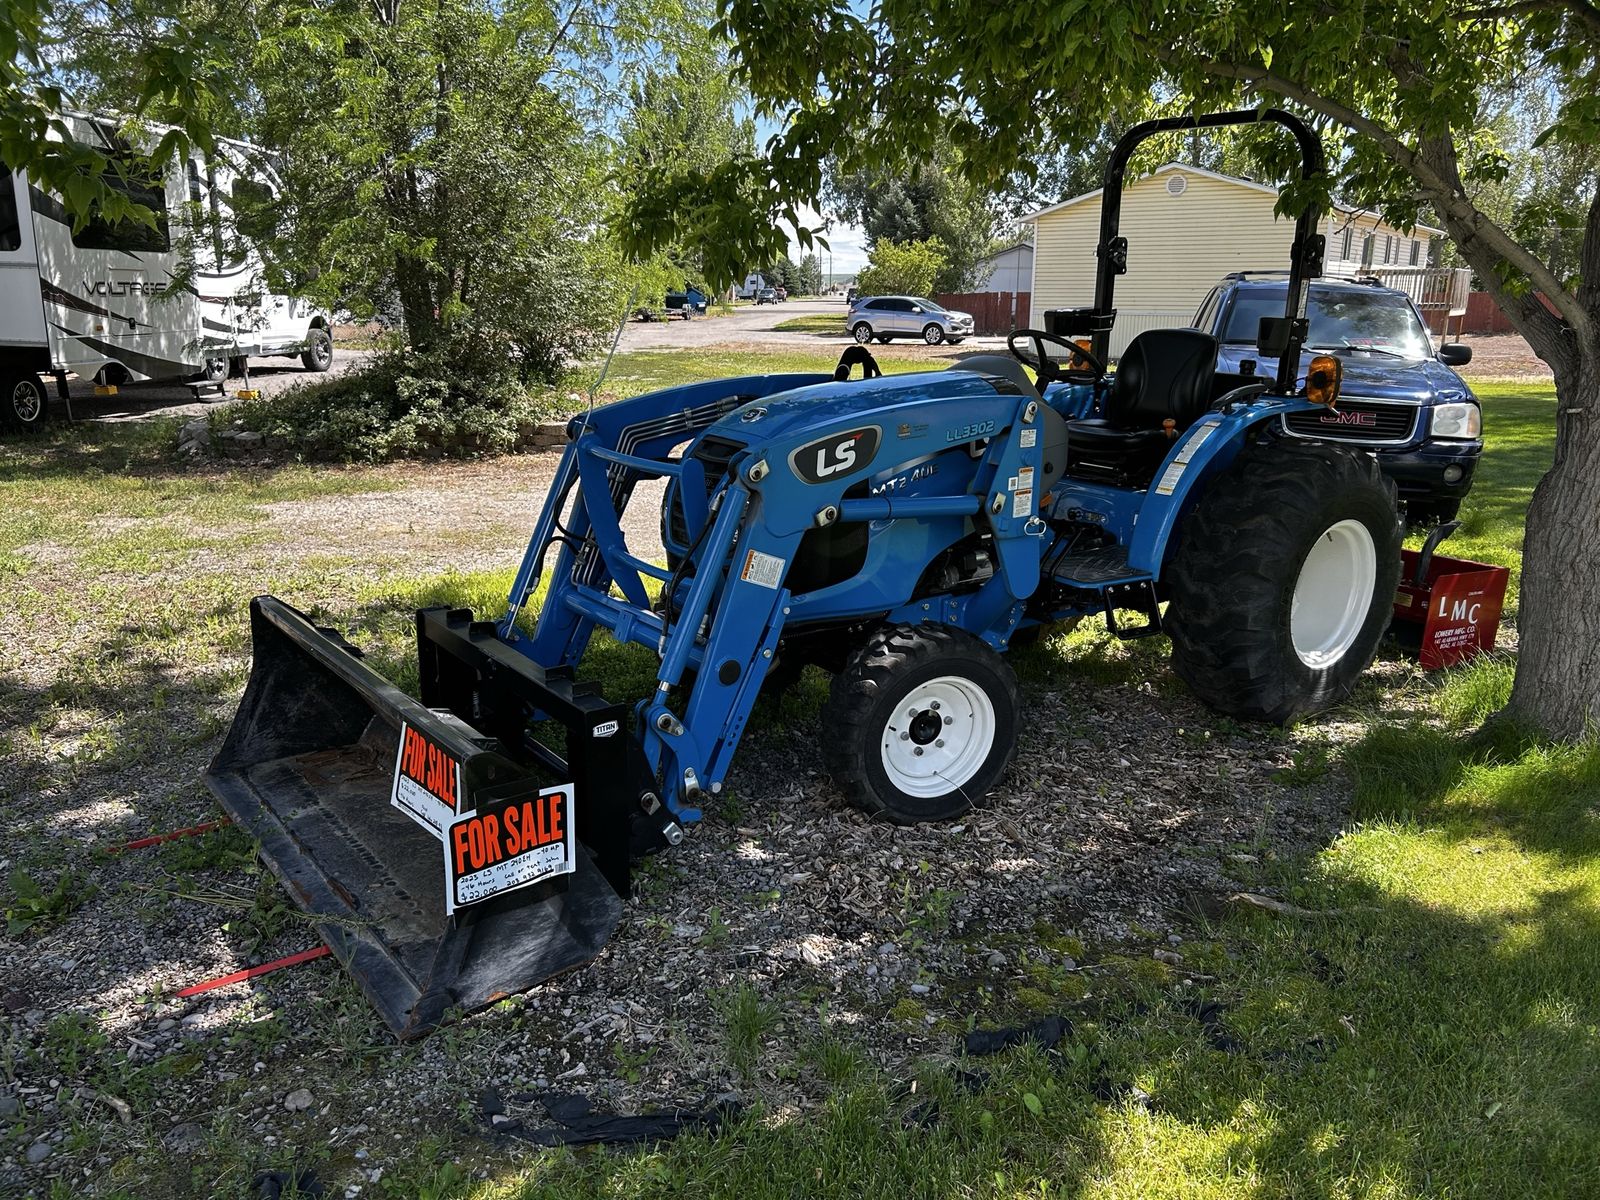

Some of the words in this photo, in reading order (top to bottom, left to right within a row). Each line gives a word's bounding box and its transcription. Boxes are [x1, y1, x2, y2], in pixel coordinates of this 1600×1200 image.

[83, 281, 167, 297] VOLTAGE
[946, 420, 994, 442] LL3302
[816, 439, 856, 477] LS
[596, 722, 615, 733] TITAN
[402, 726, 426, 784] FOR
[427, 742, 455, 807] SALE
[453, 814, 502, 874] FOR
[504, 795, 563, 855] SALE
[496, 863, 508, 871] MT
